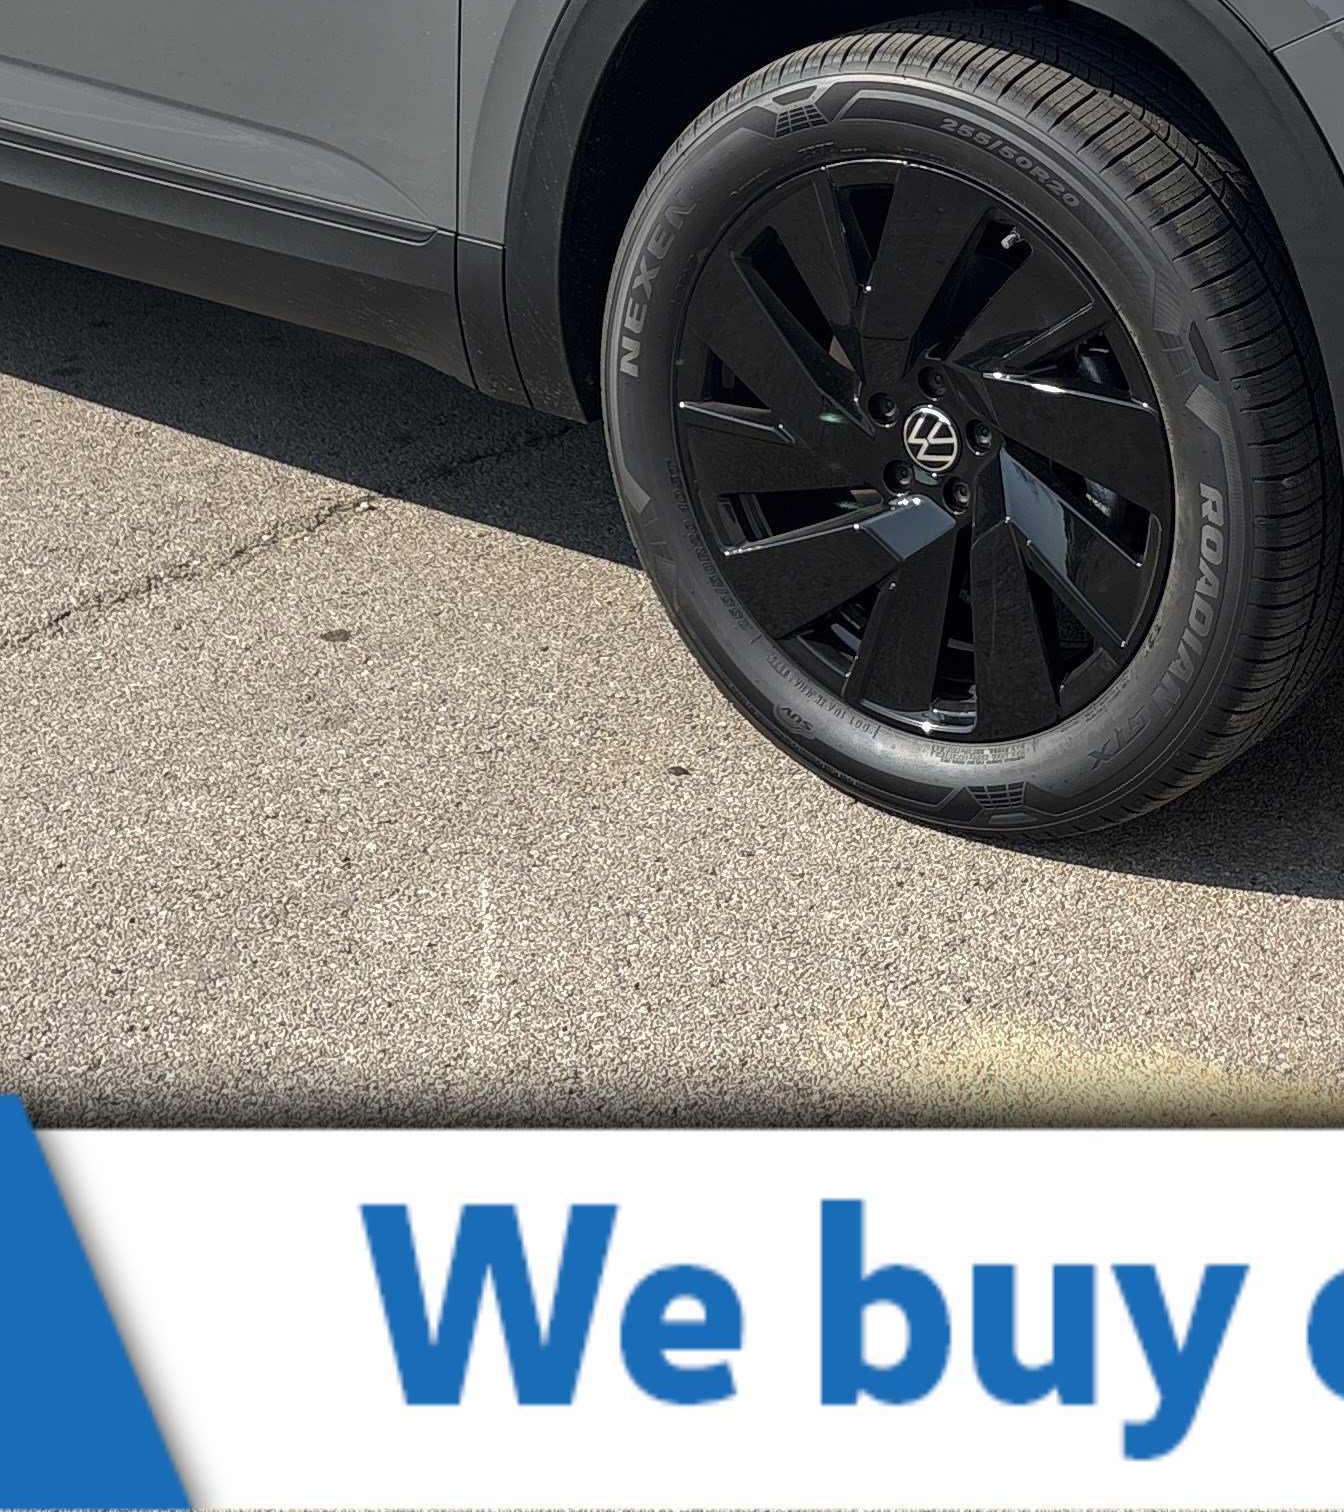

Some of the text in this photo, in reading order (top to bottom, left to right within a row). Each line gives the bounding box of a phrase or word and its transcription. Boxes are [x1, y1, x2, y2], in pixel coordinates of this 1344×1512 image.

[938, 116, 1081, 208] 255/50R20
[618, 187, 698, 378] NEXEN
[1150, 481, 1226, 718] ROADIAN
[780, 706, 815, 733] SUV
